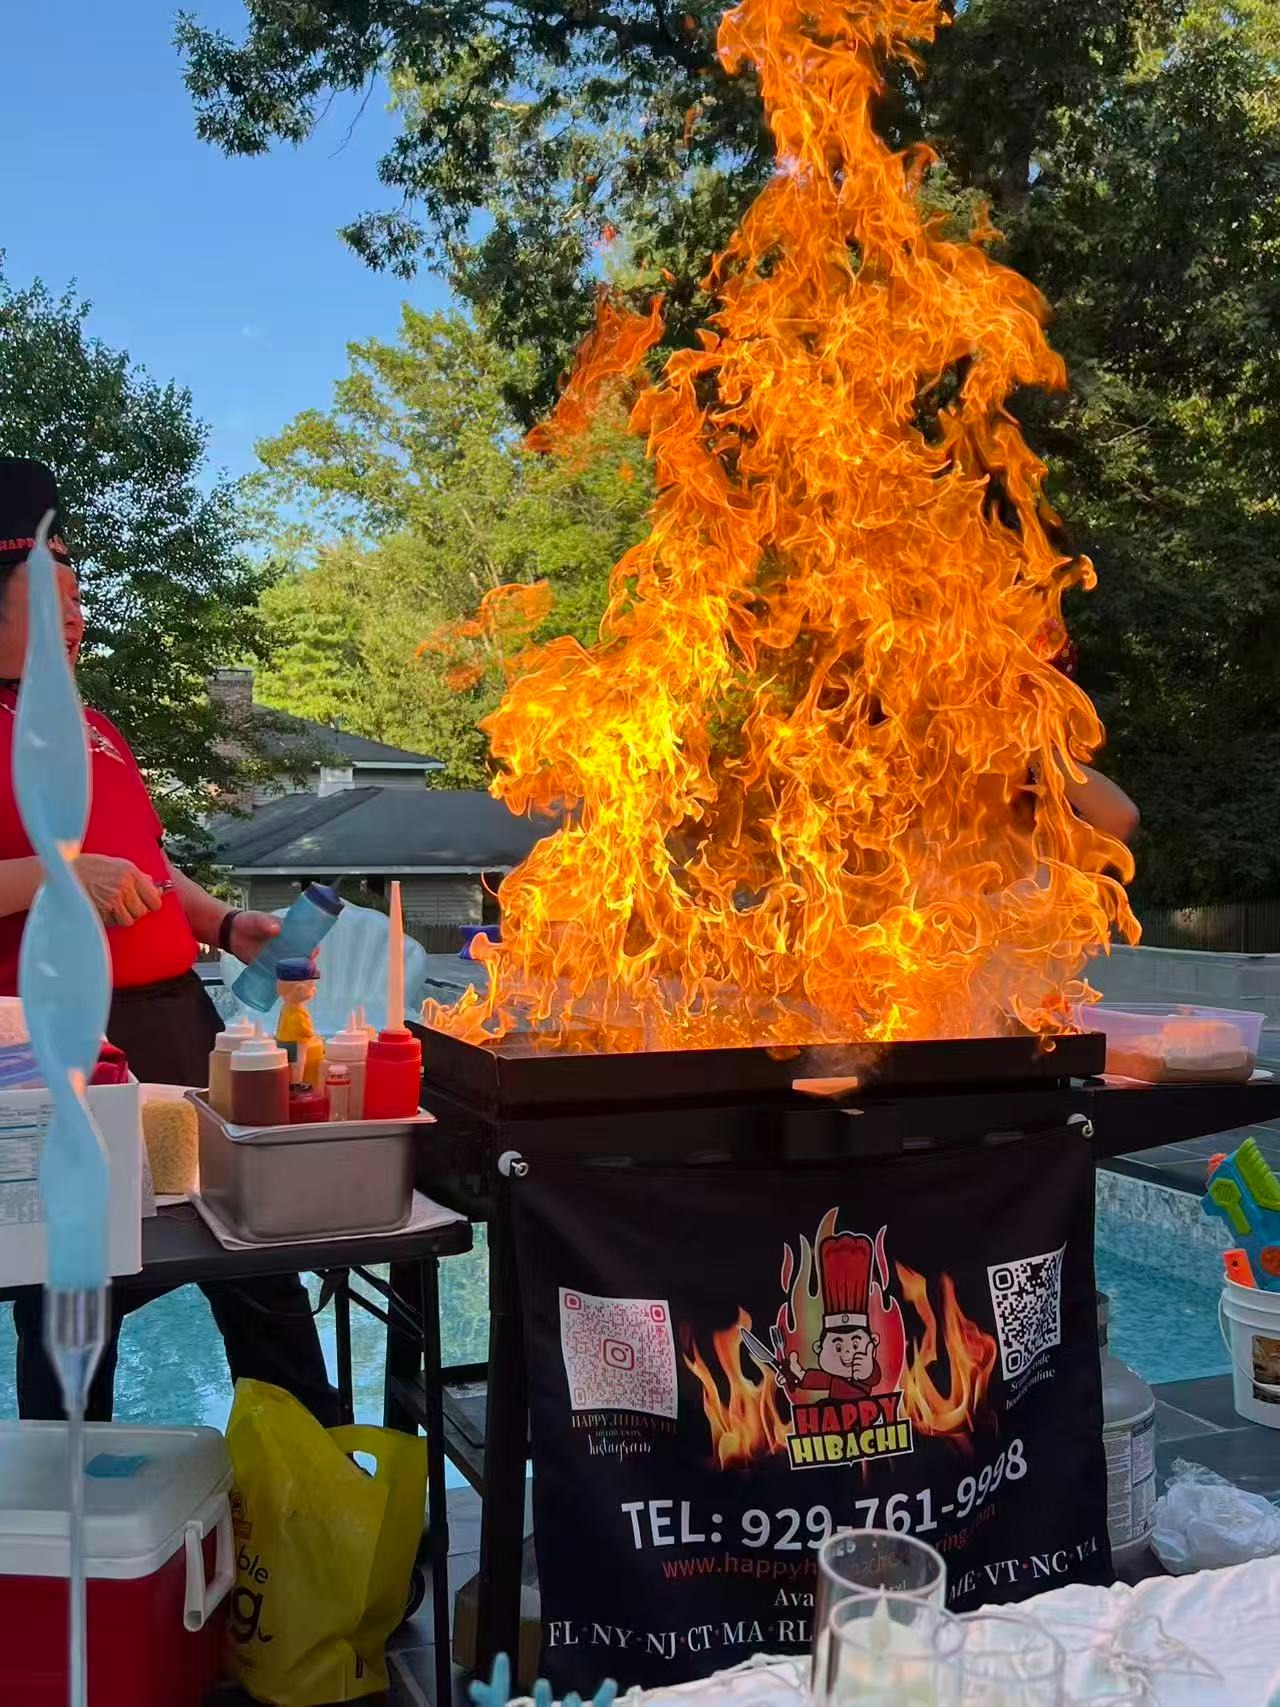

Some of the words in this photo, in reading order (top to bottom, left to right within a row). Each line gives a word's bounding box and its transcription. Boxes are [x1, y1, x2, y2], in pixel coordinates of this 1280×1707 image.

[795, 1396, 898, 1434] HAPPY
[791, 1423, 908, 1464] HIBACHI
[621, 1500, 723, 1549] TEL:
[741, 1438, 1028, 1550] 929-761-9998
[236, 1545, 269, 1584] ble
[549, 1621, 578, 1647] FL
[591, 1623, 633, 1648] NY
[647, 1632, 677, 1659] NJ
[688, 1625, 712, 1652] CT
[721, 1620, 765, 1645] MA
[984, 1559, 1019, 1586] VT
[1030, 1550, 1068, 1578] NC
